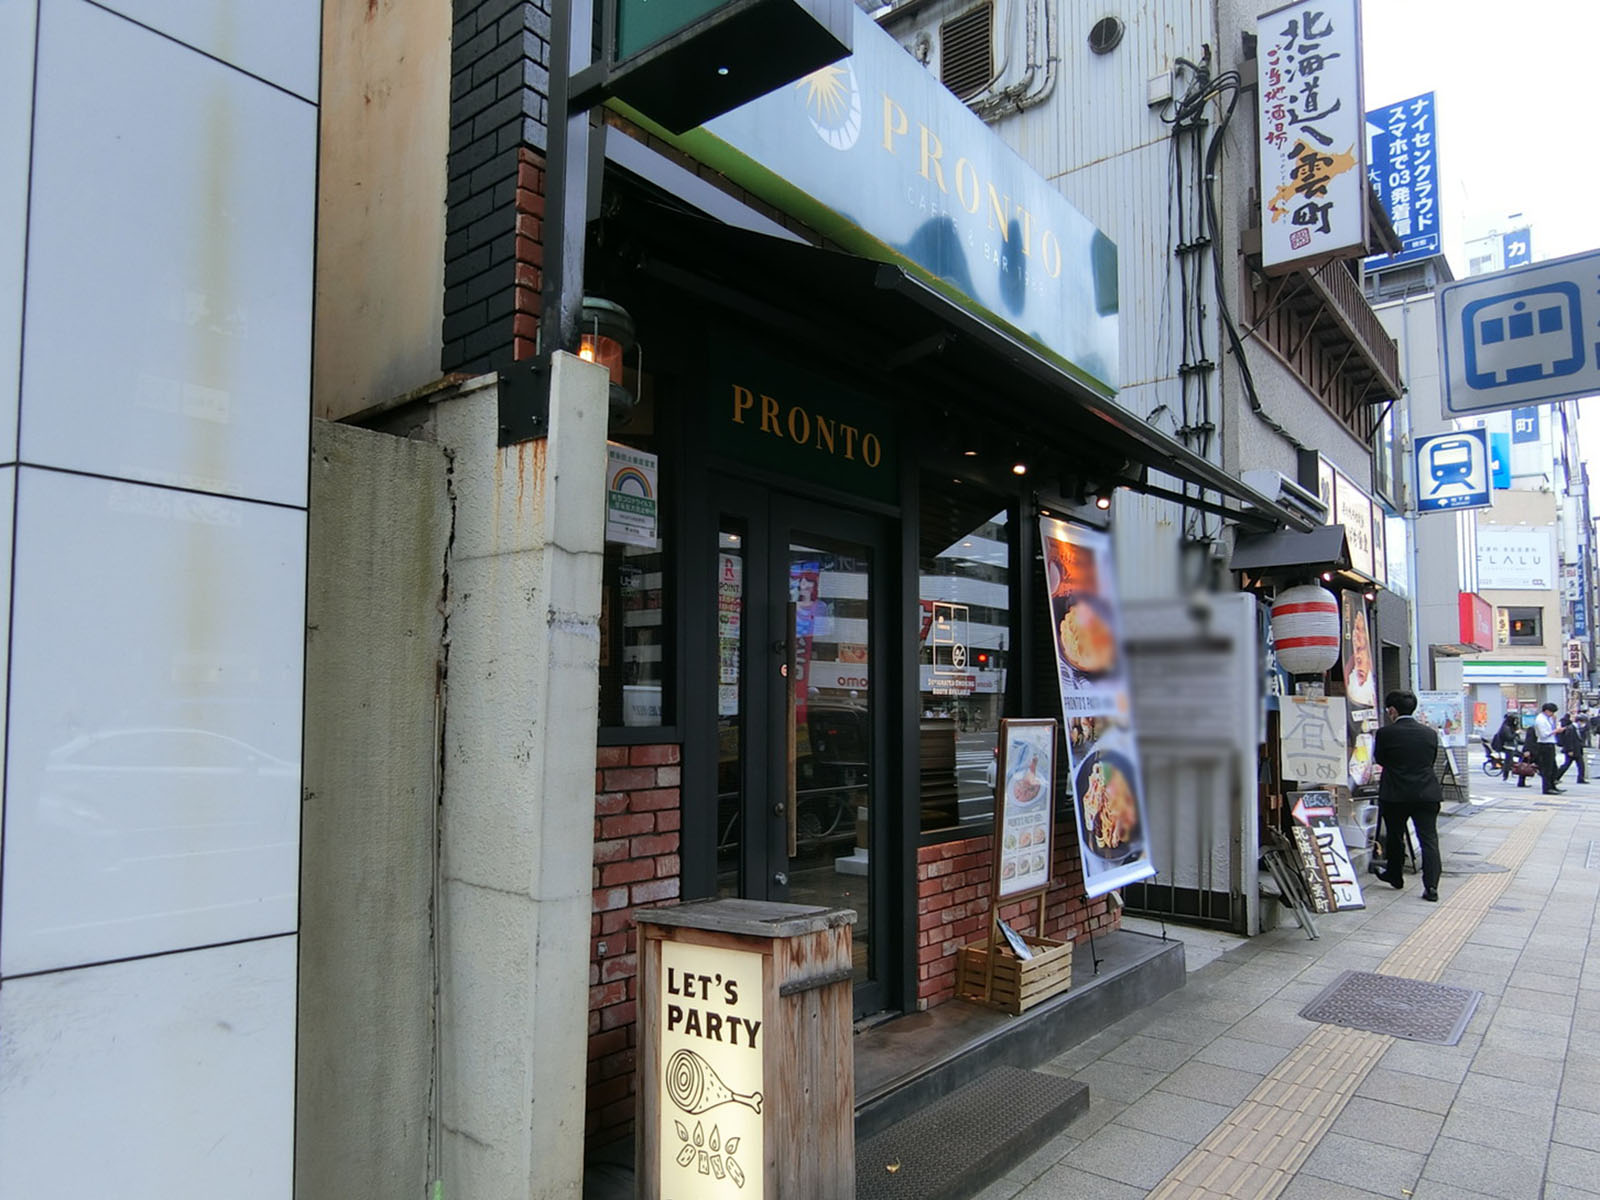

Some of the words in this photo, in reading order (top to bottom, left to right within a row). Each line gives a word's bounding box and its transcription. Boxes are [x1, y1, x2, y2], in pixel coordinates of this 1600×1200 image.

[1264, 44, 1289, 150] ご当地酒場
[1280, 11, 1341, 234] 北海道八雲町
[880, 91, 1062, 279] PRONTO
[1389, 106, 1412, 237] スマホで03発着信
[1410, 99, 1435, 232] ナイセンクラウド
[984, 242, 1009, 273] BAR
[731, 384, 882, 469] PRONTO
[667, 967, 739, 1006] LET'S
[667, 1004, 762, 1049] PARTY
